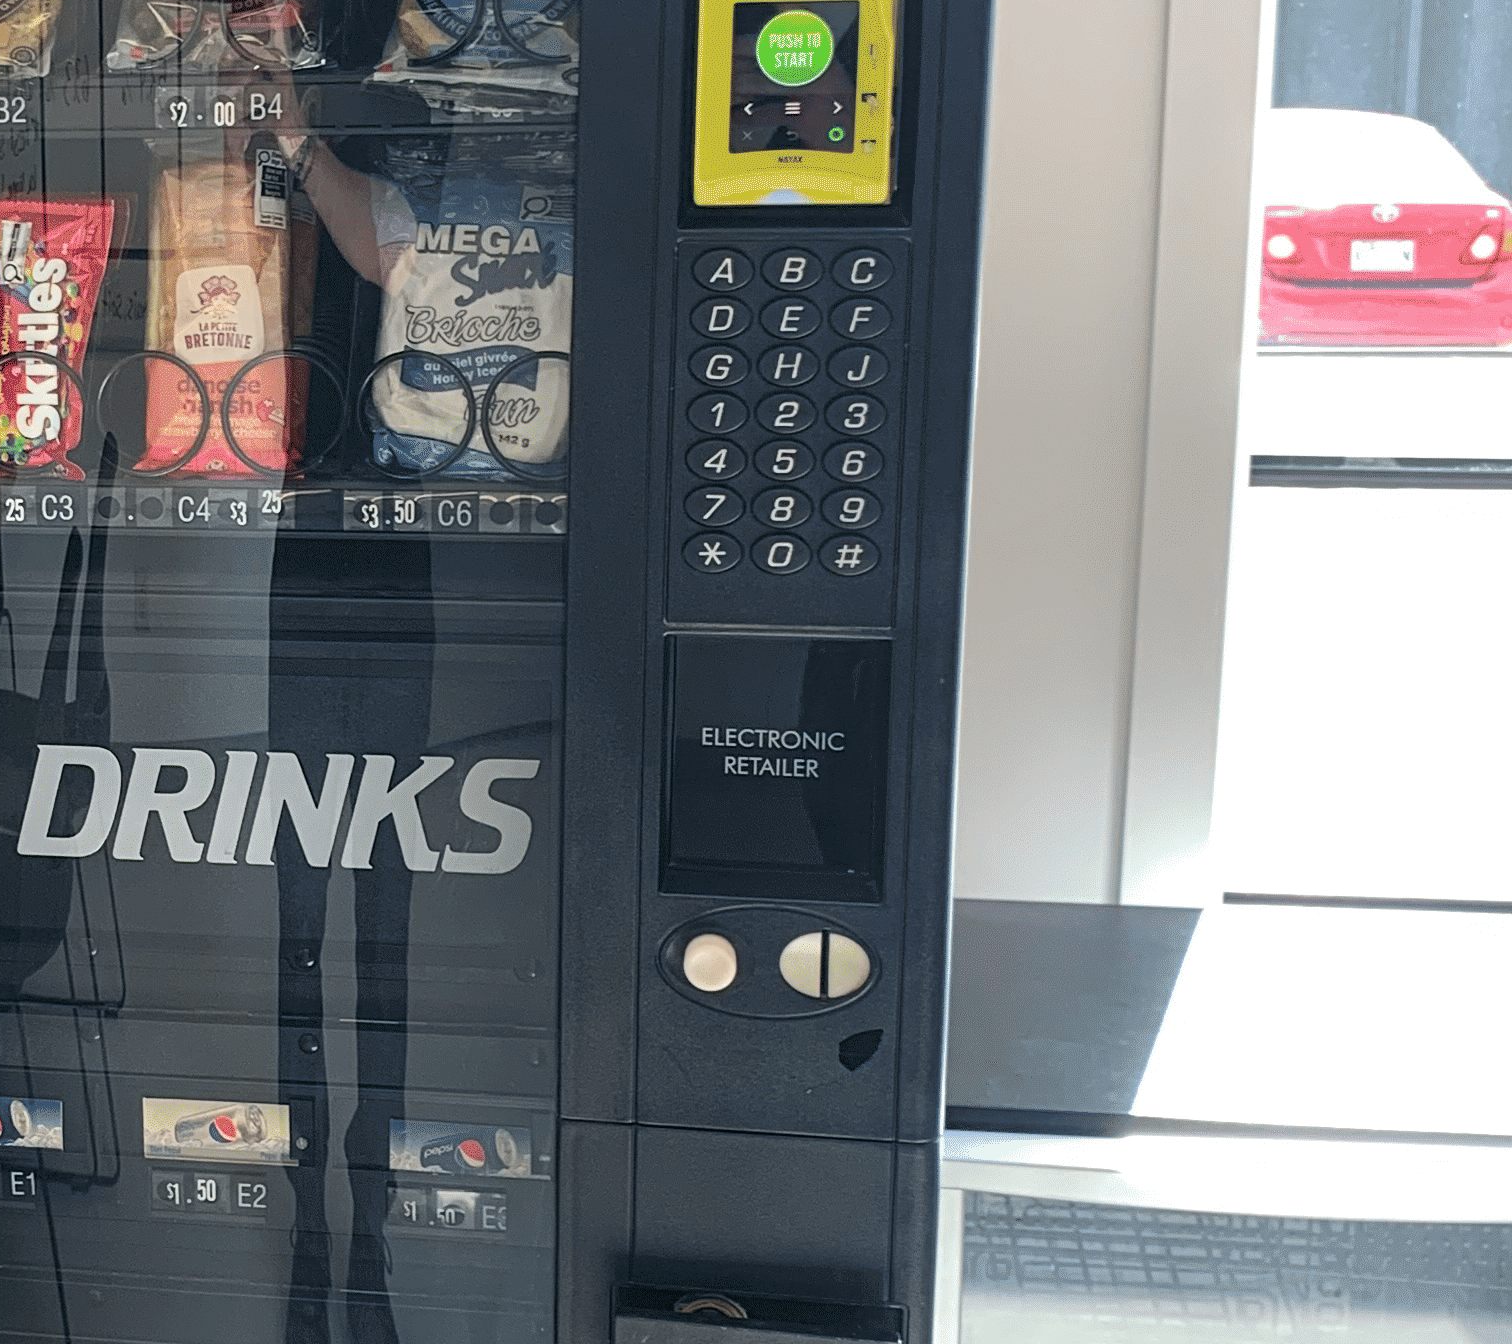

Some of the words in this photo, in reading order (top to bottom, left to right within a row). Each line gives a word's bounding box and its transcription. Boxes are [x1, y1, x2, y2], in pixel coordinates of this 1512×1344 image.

[768, 32, 804, 49] PUSH
[807, 32, 822, 48] TO
[774, 52, 815, 69] START
[249, 94, 283, 121] B4
[415, 222, 541, 257] MEGA
[709, 257, 734, 284] A
[780, 257, 807, 283] B
[850, 257, 876, 284] C
[405, 305, 541, 347] Brioche
[708, 306, 735, 331] D
[779, 306, 805, 332] E
[849, 307, 873, 333] F
[16, 258, 68, 441] Skittles
[184, 331, 253, 351] BRETONNE
[423, 363, 441, 372] au
[442, 355, 472, 370] iel
[475, 351, 518, 367] givrée
[706, 355, 733, 380] G
[774, 352, 802, 379] H
[847, 355, 870, 381] J
[176, 375, 261, 395] dnose
[433, 370, 474, 385] Hony
[182, 395, 254, 415] dansh
[710, 402, 725, 427] 1
[774, 401, 799, 427] 2
[844, 403, 869, 428] 3
[498, 434, 518, 445] 142
[521, 438, 531, 448] g
[704, 448, 727, 474] 4
[773, 449, 797, 474] 5
[842, 450, 866, 476] 6
[42, 494, 74, 522] C3
[178, 496, 211, 522] C4
[361, 499, 416, 527] $3.50
[438, 500, 473, 526] C6
[703, 495, 726, 520] 7
[770, 497, 794, 522] 8
[840, 497, 865, 523] 9
[767, 542, 794, 568] 0
[835, 544, 864, 569] #
[701, 727, 846, 752] ELECTRONIC
[724, 755, 820, 779] RETAILER
[16, 743, 542, 875] DRINKS
[423, 1142, 454, 1159] pepsi
[11, 1172, 36, 1196] E1
[166, 1178, 217, 1205] $1.50
[238, 1183, 267, 1209] E2
